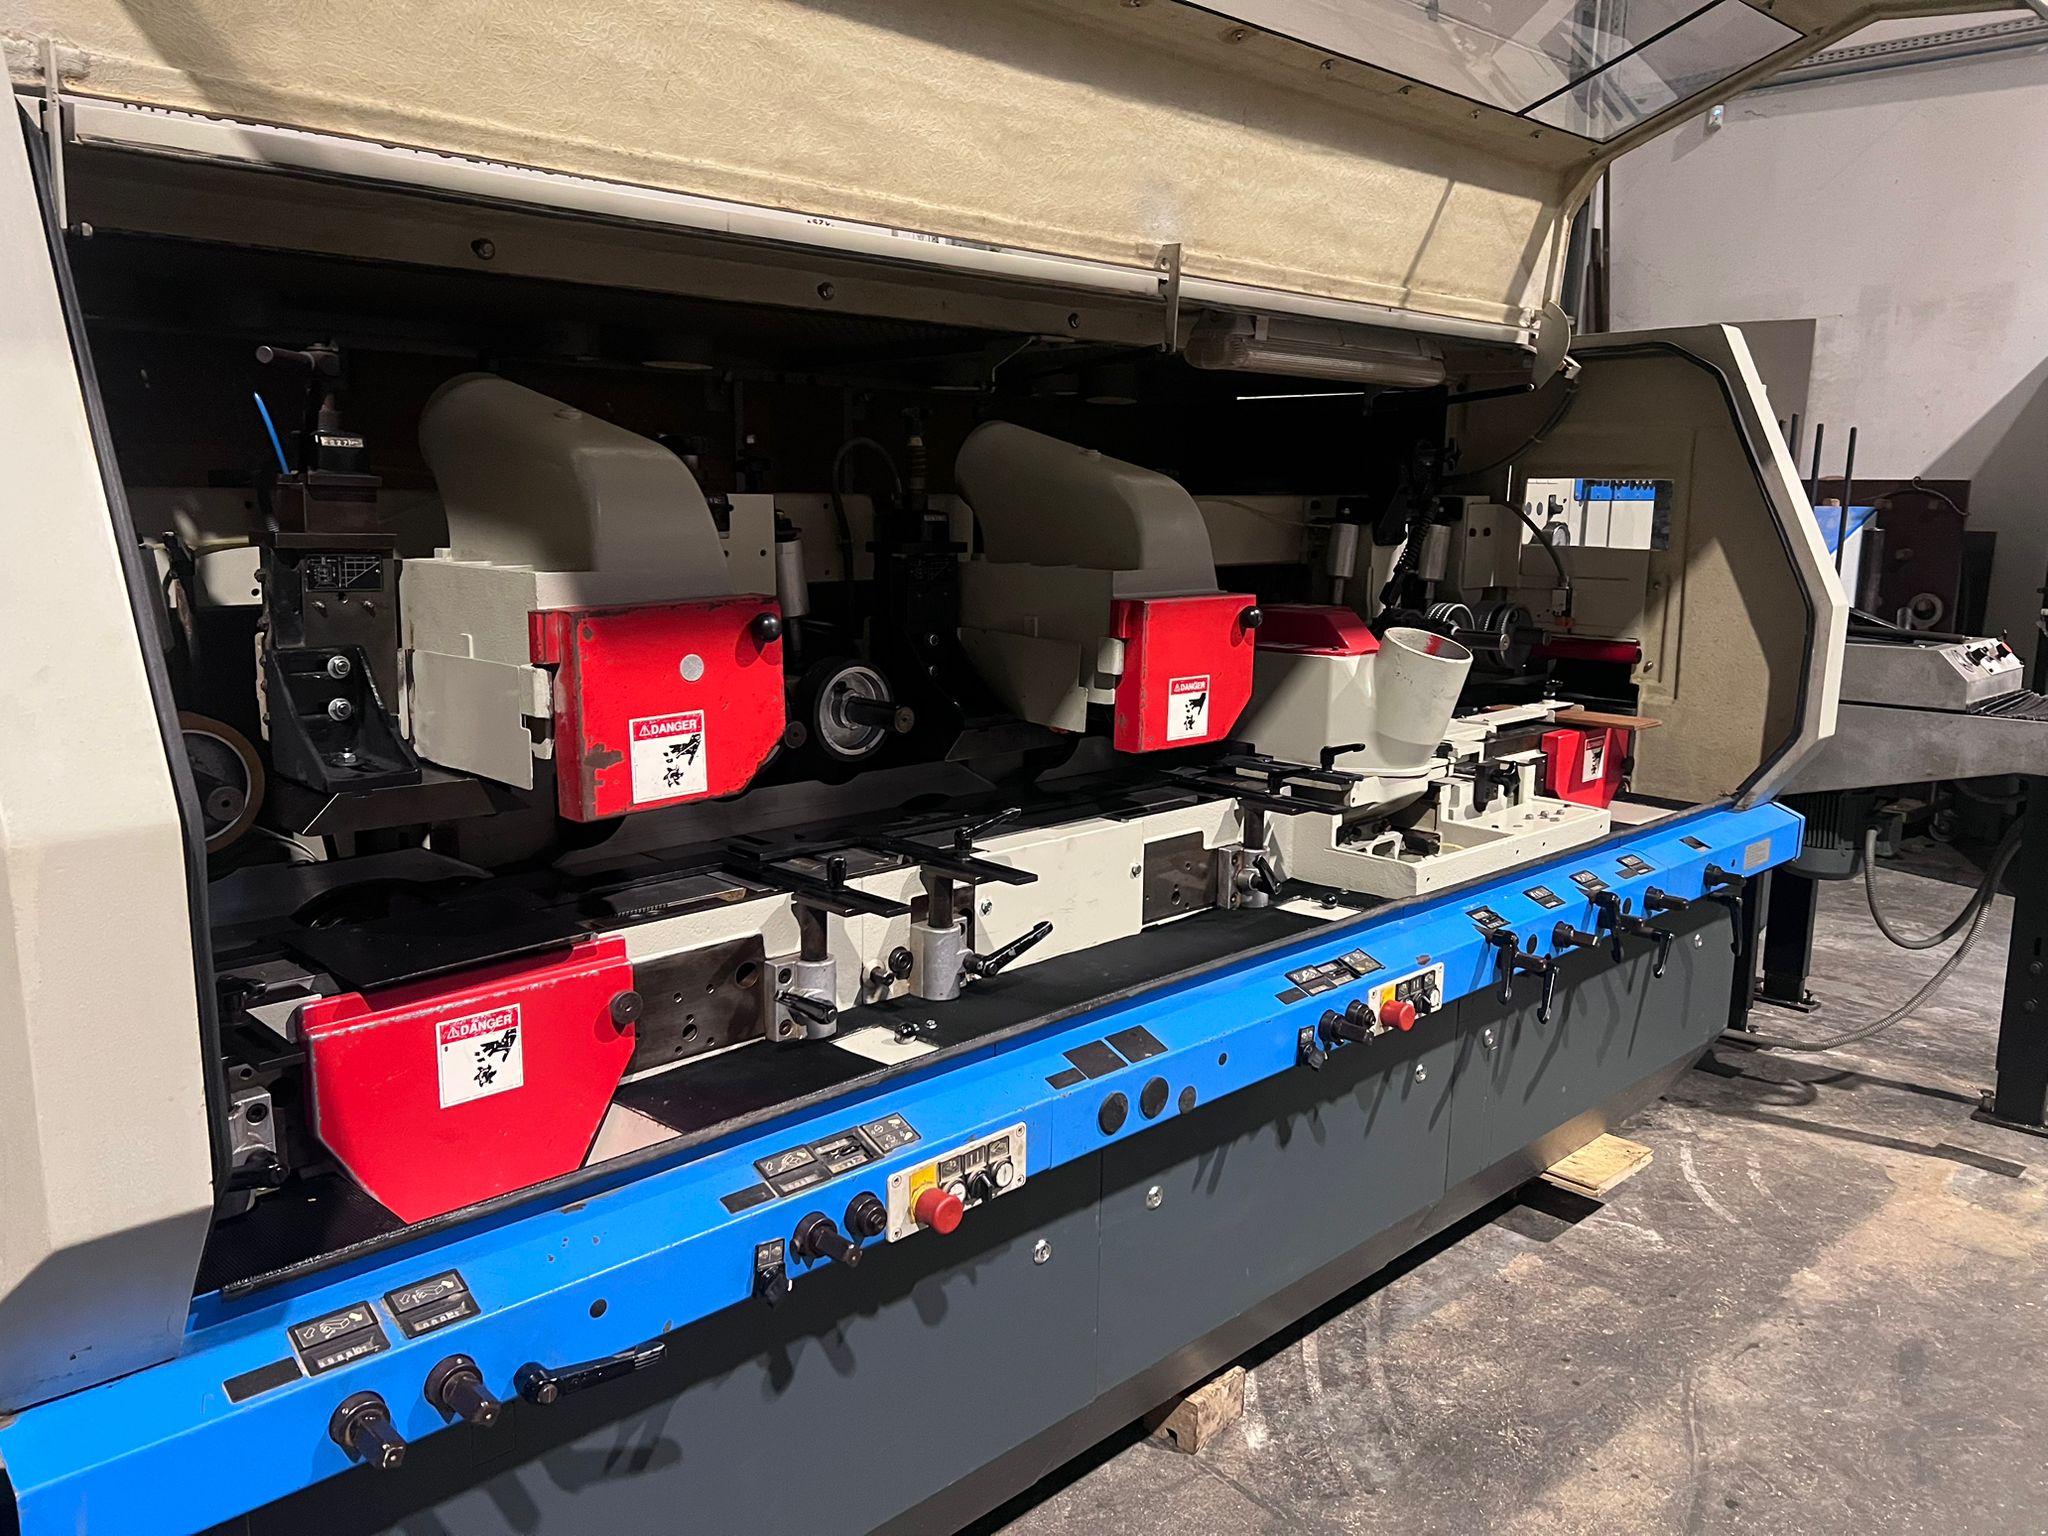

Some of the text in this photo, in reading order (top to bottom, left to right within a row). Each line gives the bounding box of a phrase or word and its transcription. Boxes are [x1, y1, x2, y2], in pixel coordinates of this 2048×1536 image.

[1180, 680, 1206, 692] DANGER
[650, 719, 697, 735] DANGER
[460, 1013, 513, 1036] DANGER
